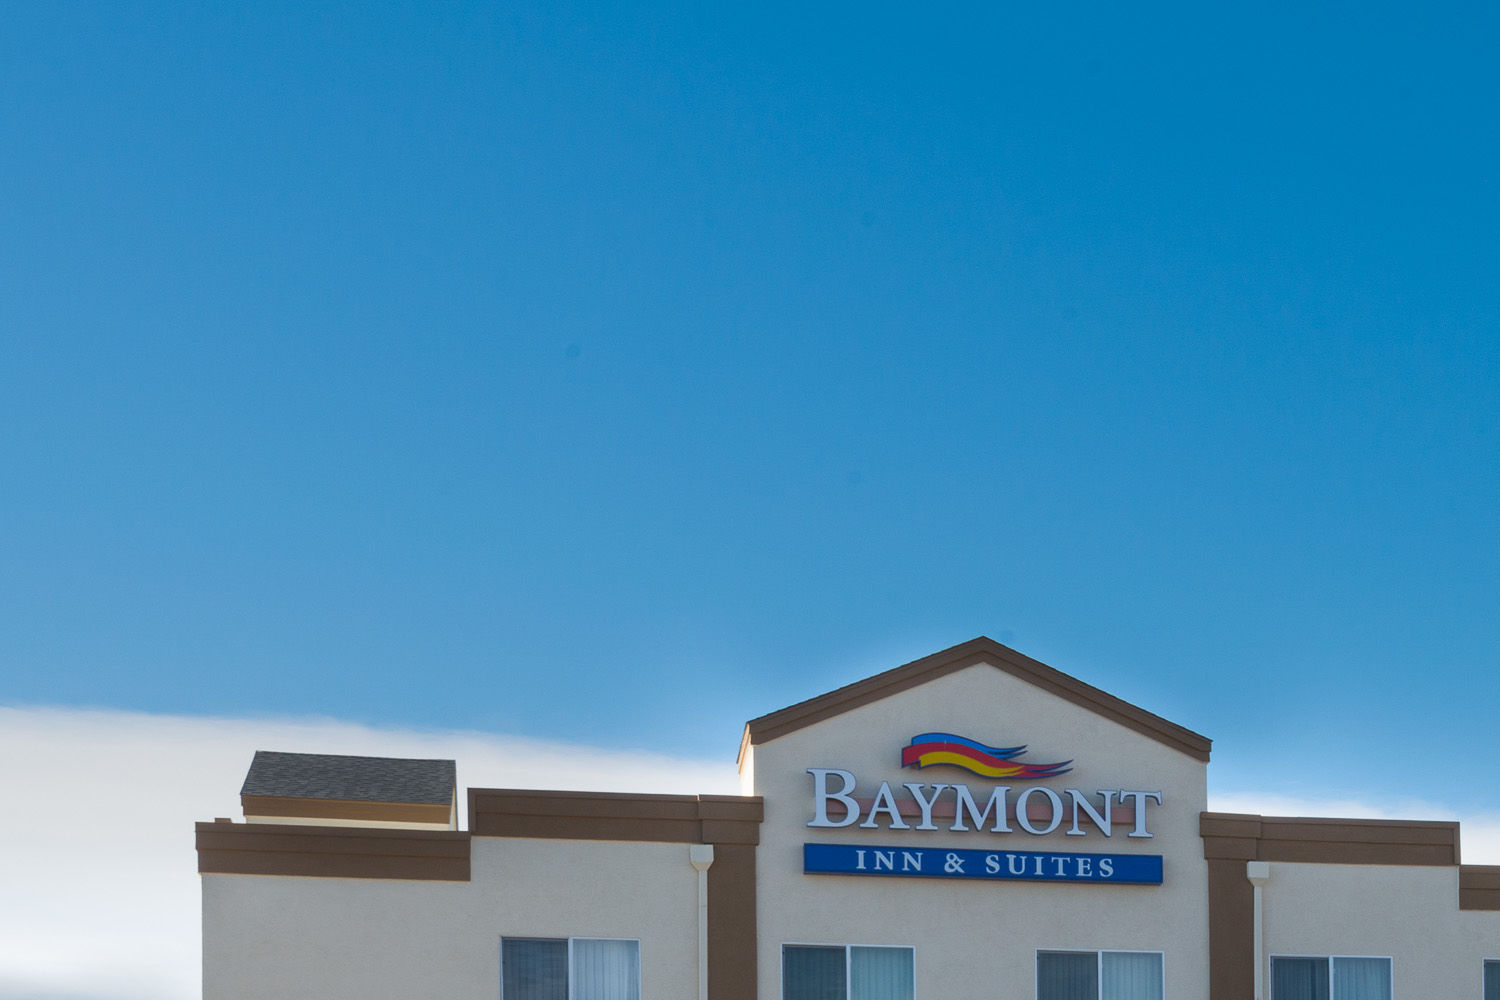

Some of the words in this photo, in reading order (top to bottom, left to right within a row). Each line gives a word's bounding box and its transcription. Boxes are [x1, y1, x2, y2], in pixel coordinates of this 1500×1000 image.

[806, 768, 1162, 838] BAYMONT
[856, 850, 924, 872] INN
[943, 852, 966, 874] &
[985, 854, 1115, 878] SUITES
